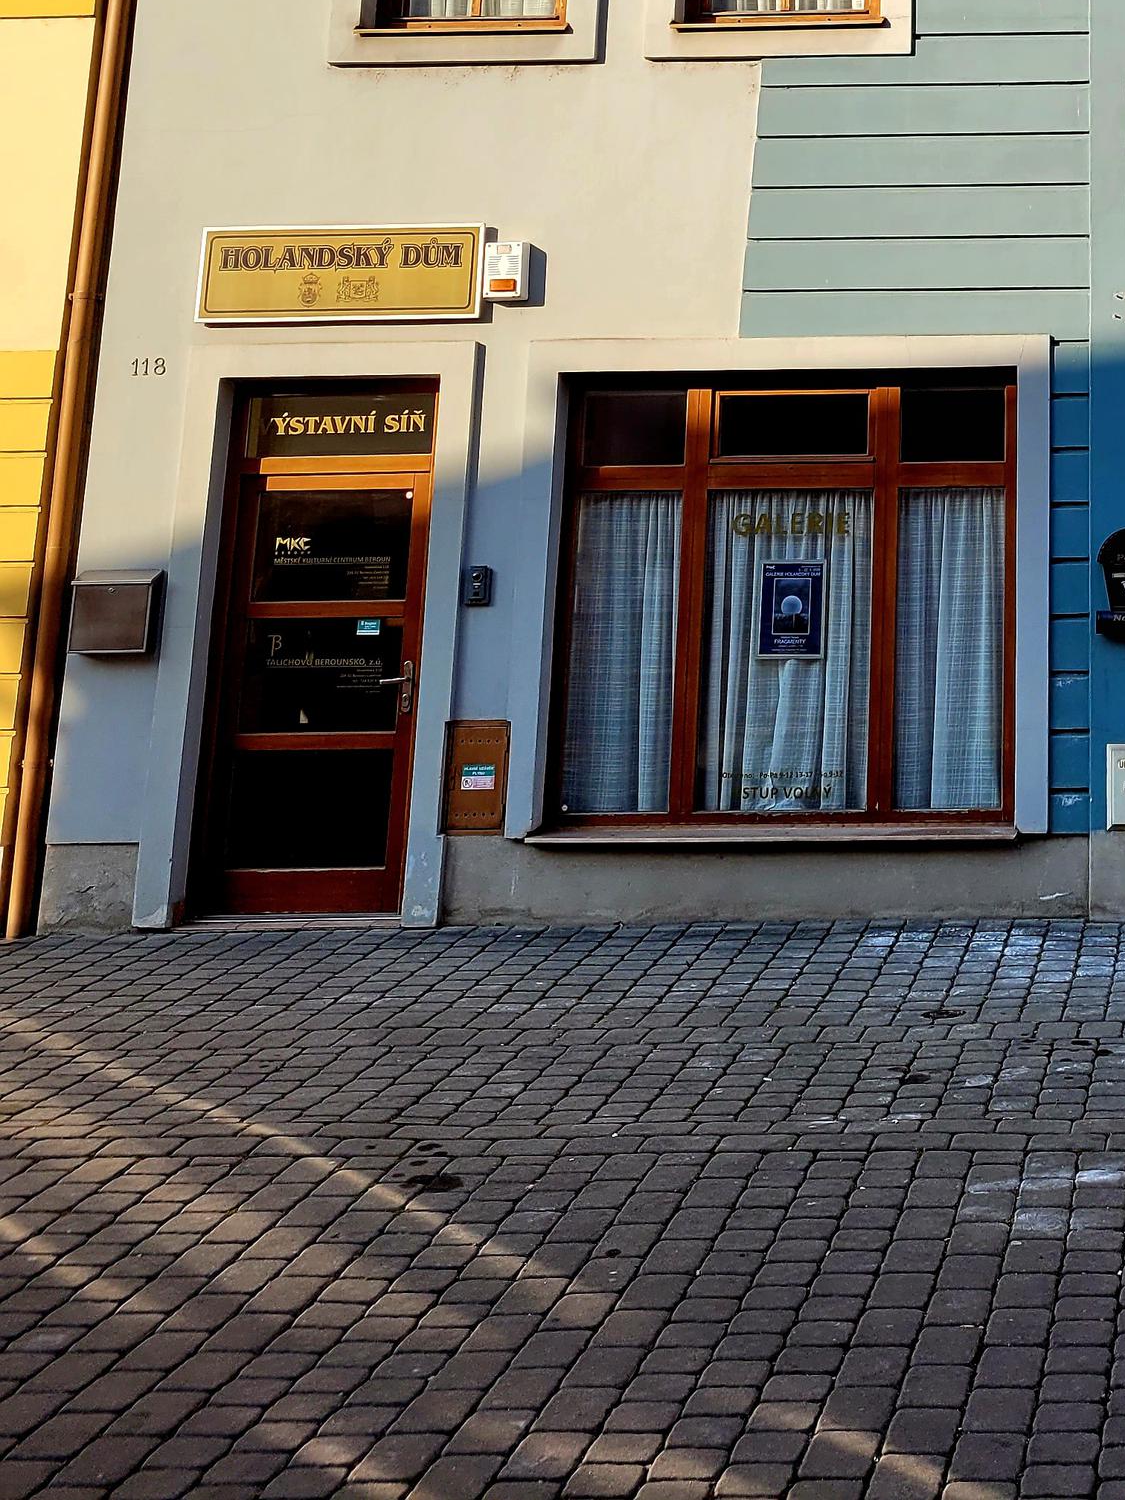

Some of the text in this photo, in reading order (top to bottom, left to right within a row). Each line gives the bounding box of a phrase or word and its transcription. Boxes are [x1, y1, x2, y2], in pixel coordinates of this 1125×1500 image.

[219, 237, 464, 273] HOLANDSKÝ DŮM
[131, 357, 166, 376] 118
[384, 409, 426, 434] SÍŇ
[732, 511, 849, 537] GALERIE
[275, 537, 312, 551] MKC
[738, 786, 779, 800] STUP
